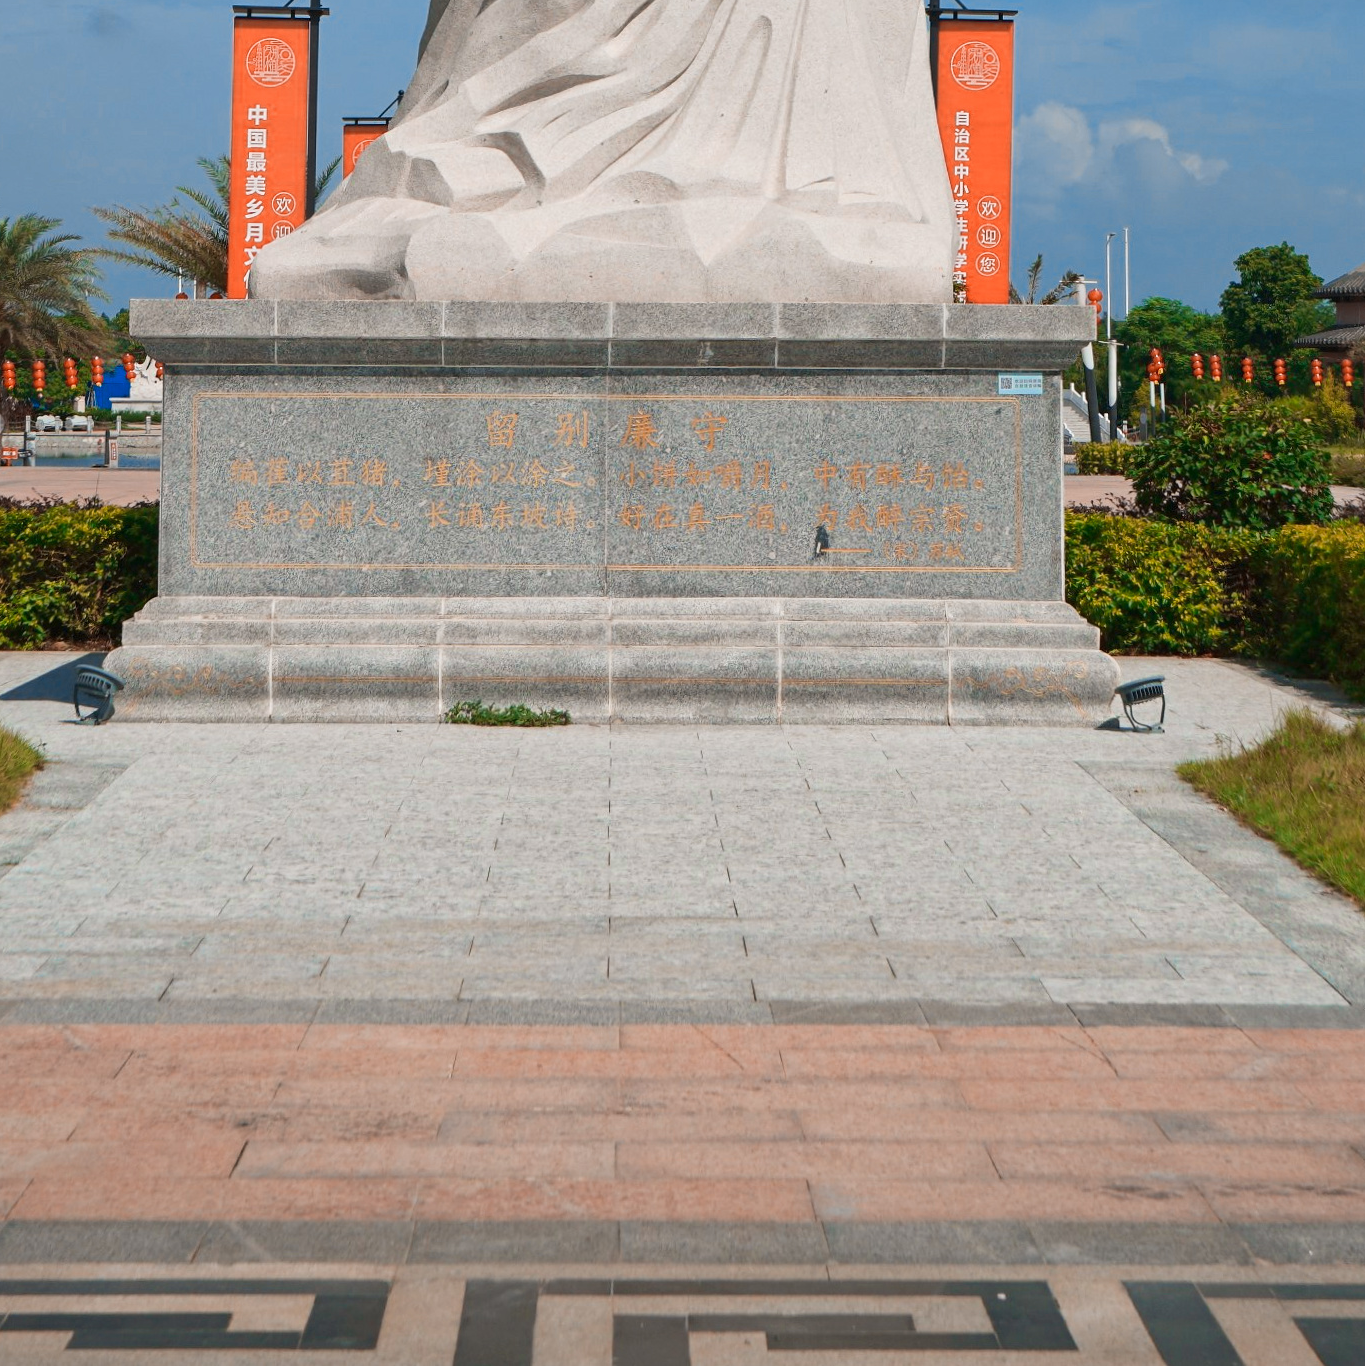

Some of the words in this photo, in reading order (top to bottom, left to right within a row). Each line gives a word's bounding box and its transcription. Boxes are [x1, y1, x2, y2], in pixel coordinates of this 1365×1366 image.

[979, 199, 999, 273] 欢迎您
[485, 410, 728, 452] 留别廉守
